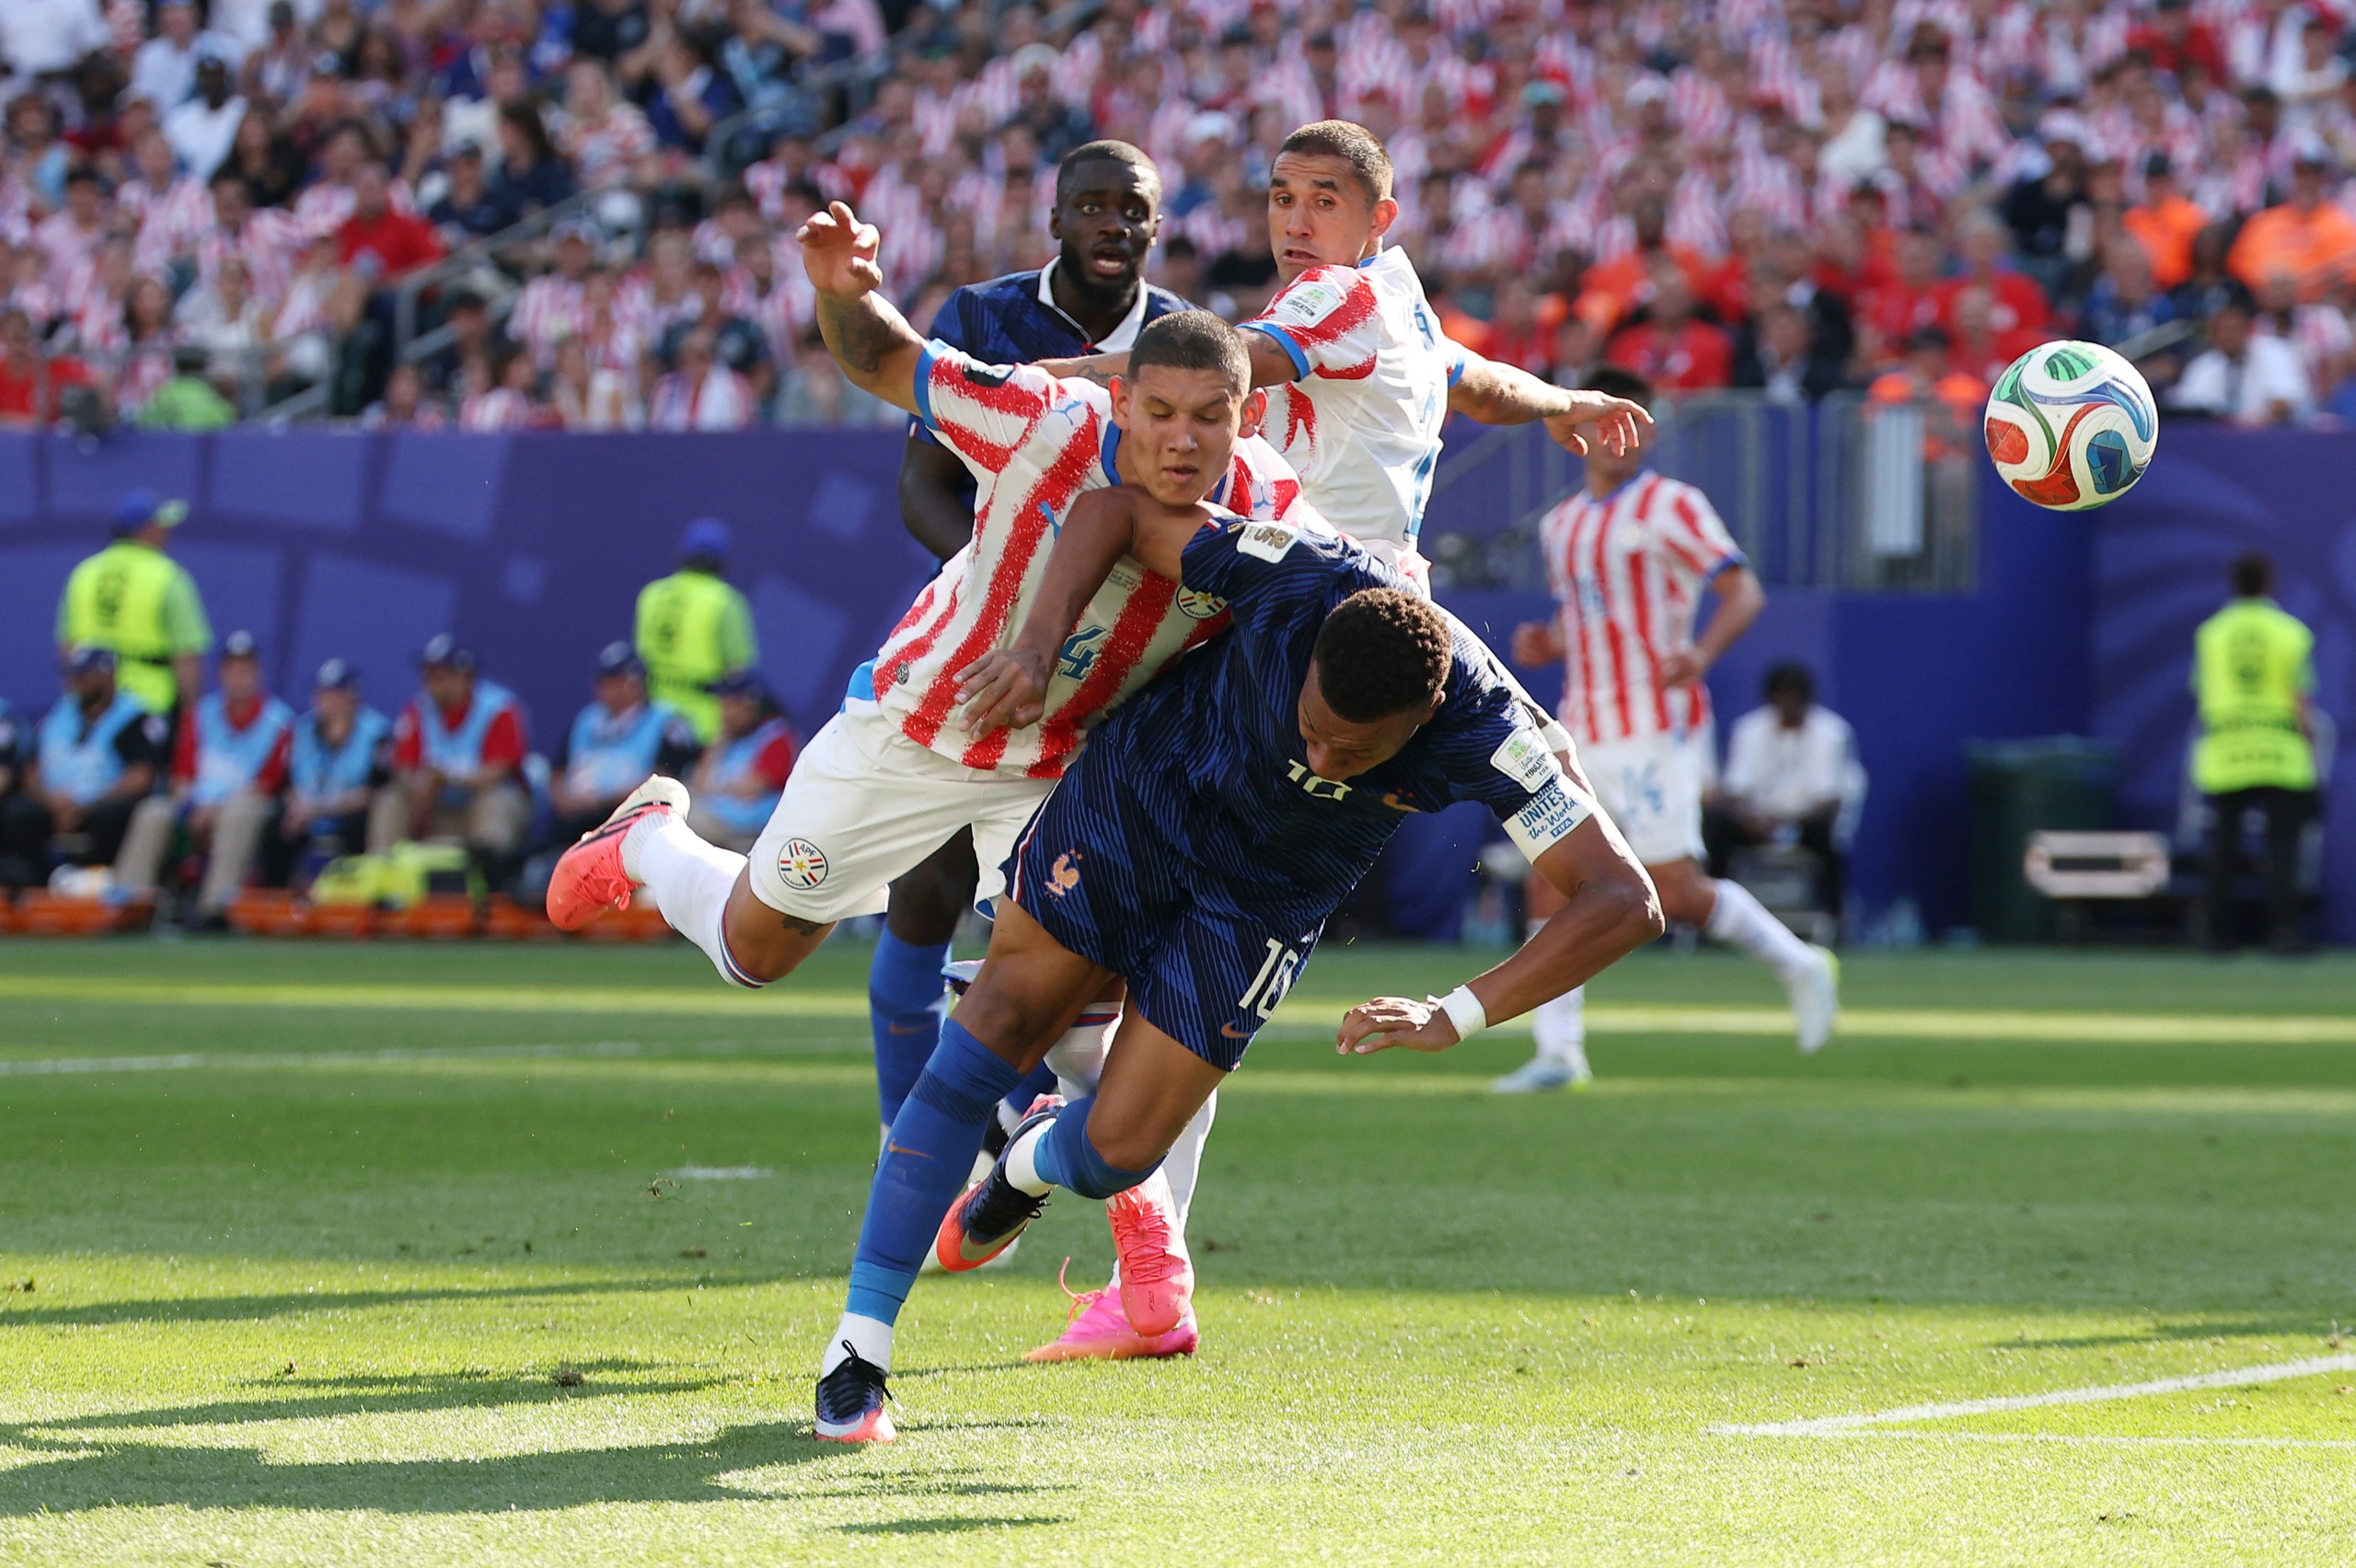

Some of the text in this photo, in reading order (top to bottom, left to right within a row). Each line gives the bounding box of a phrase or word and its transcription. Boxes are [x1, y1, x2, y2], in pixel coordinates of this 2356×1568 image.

[1286, 299, 1315, 317] EDUCATION
[1059, 625, 1107, 681] 4
[1539, 766, 1549, 776] FIFA
[1519, 786, 1565, 828] UNITES
[1528, 797, 1578, 840] the World
[1551, 817, 1574, 837] FIFA
[799, 844, 816, 857] APF
[1238, 938, 1299, 1020] 10
